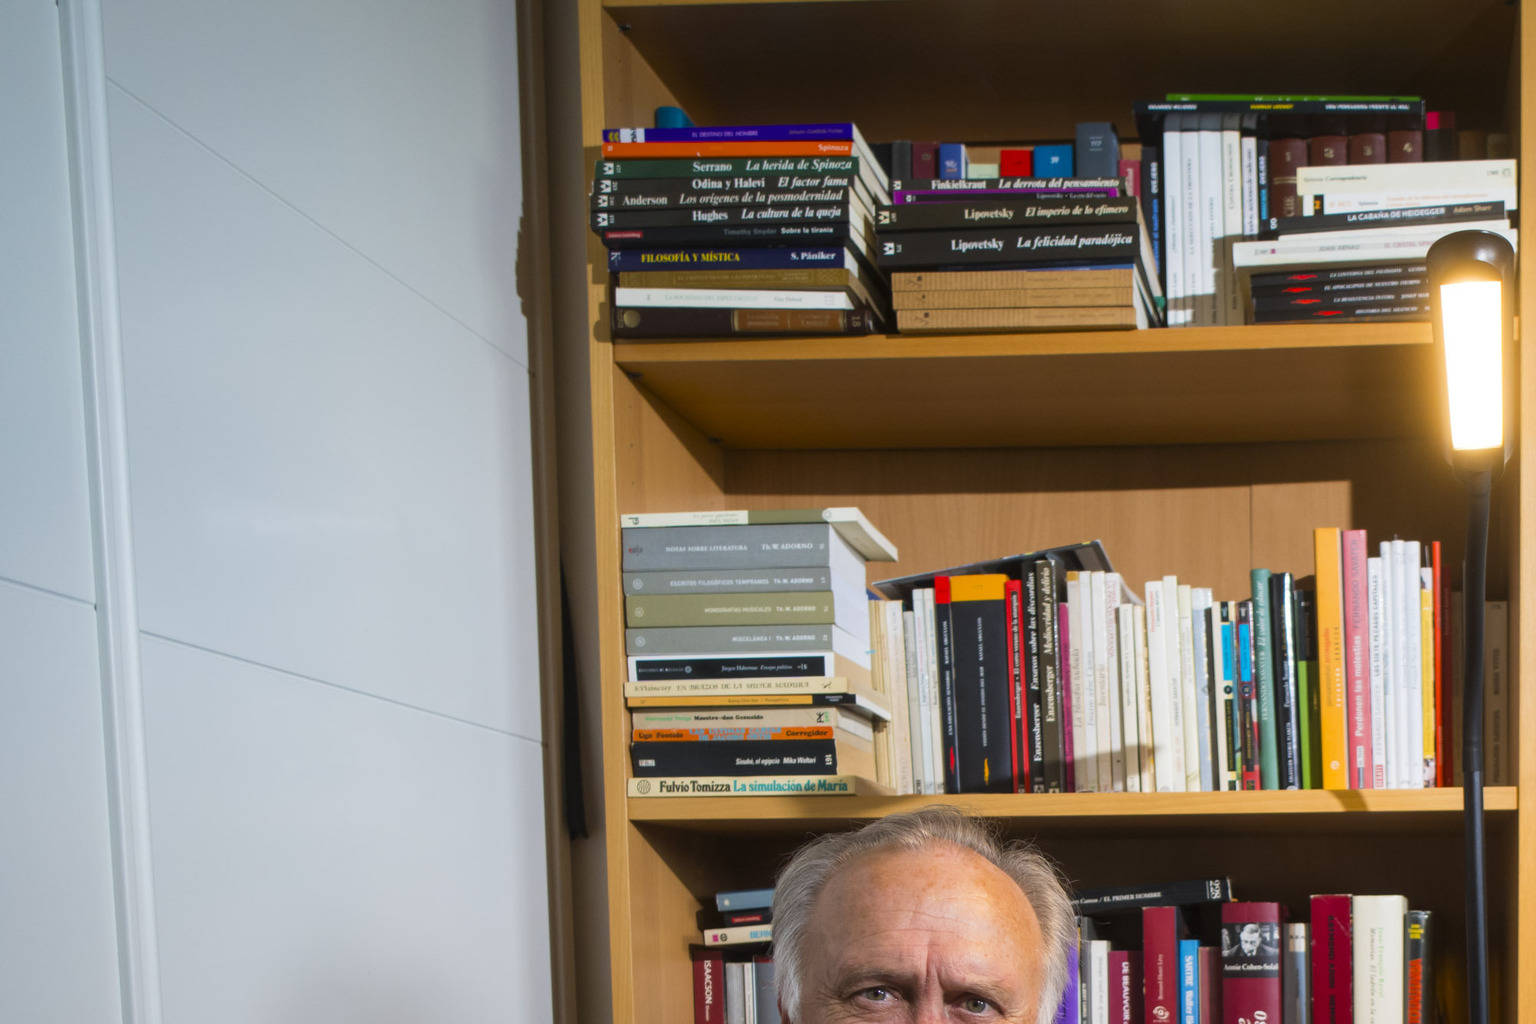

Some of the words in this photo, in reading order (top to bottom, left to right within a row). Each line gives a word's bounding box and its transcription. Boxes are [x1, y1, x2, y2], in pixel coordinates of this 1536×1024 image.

[693, 163, 732, 172] Serrano
[746, 160, 759, 171] La
[761, 160, 795, 170] herida
[799, 160, 808, 169] de
[812, 159, 852, 171] Spinoza
[692, 179, 722, 189] Odina
[725, 180, 731, 189] y
[734, 177, 765, 188] Halevi
[778, 177, 789, 187] El
[791, 176, 820, 188] factor
[823, 177, 848, 188] fama
[622, 196, 668, 205] Anderson
[680, 194, 697, 204] Los
[699, 193, 739, 205] orígenes
[742, 194, 752, 203] de
[755, 192, 765, 203] la
[768, 191, 843, 204] posmodernidad
[692, 211, 728, 222] Hughes
[741, 209, 754, 219] La
[757, 208, 789, 218] cultura
[792, 208, 801, 217] de
[805, 208, 814, 217] la
[817, 207, 841, 219] queja
[964, 208, 1014, 219] Lipovetsky
[1025, 207, 1036, 217] El
[1038, 206, 1071, 218] imperio
[1073, 206, 1082, 215] de
[1085, 205, 1093, 214] lo
[951, 239, 1003, 251] Lipovetsky
[1017, 237, 1030, 248] La
[1033, 236, 1076, 248] felicidad
[1079, 234, 1133, 247] paradójica
[641, 252, 690, 263] FILOSOFÍA
[701, 251, 740, 262] MÍSTICA
[791, 252, 798, 260] S.
[801, 251, 836, 260] Pániker
[1353, 635, 1361, 677] molestias
[1031, 655, 1039, 690] Ensayos
[1355, 695, 1364, 737] Perdonen
[639, 732, 652, 741] Ugo
[656, 731, 683, 739] Foscolo
[1032, 703, 1041, 762] Enzensberger
[660, 781, 689, 792] Fulvio
[690, 780, 730, 792] Tomizza
[734, 780, 746, 791] La
[749, 780, 802, 792] simulación
[804, 780, 816, 791] de
[818, 779, 848, 792] María
[1121, 961, 1130, 974] DE
[704, 960, 712, 1004] ISAACSON
[1122, 977, 1130, 1022] BEAUVOIR
